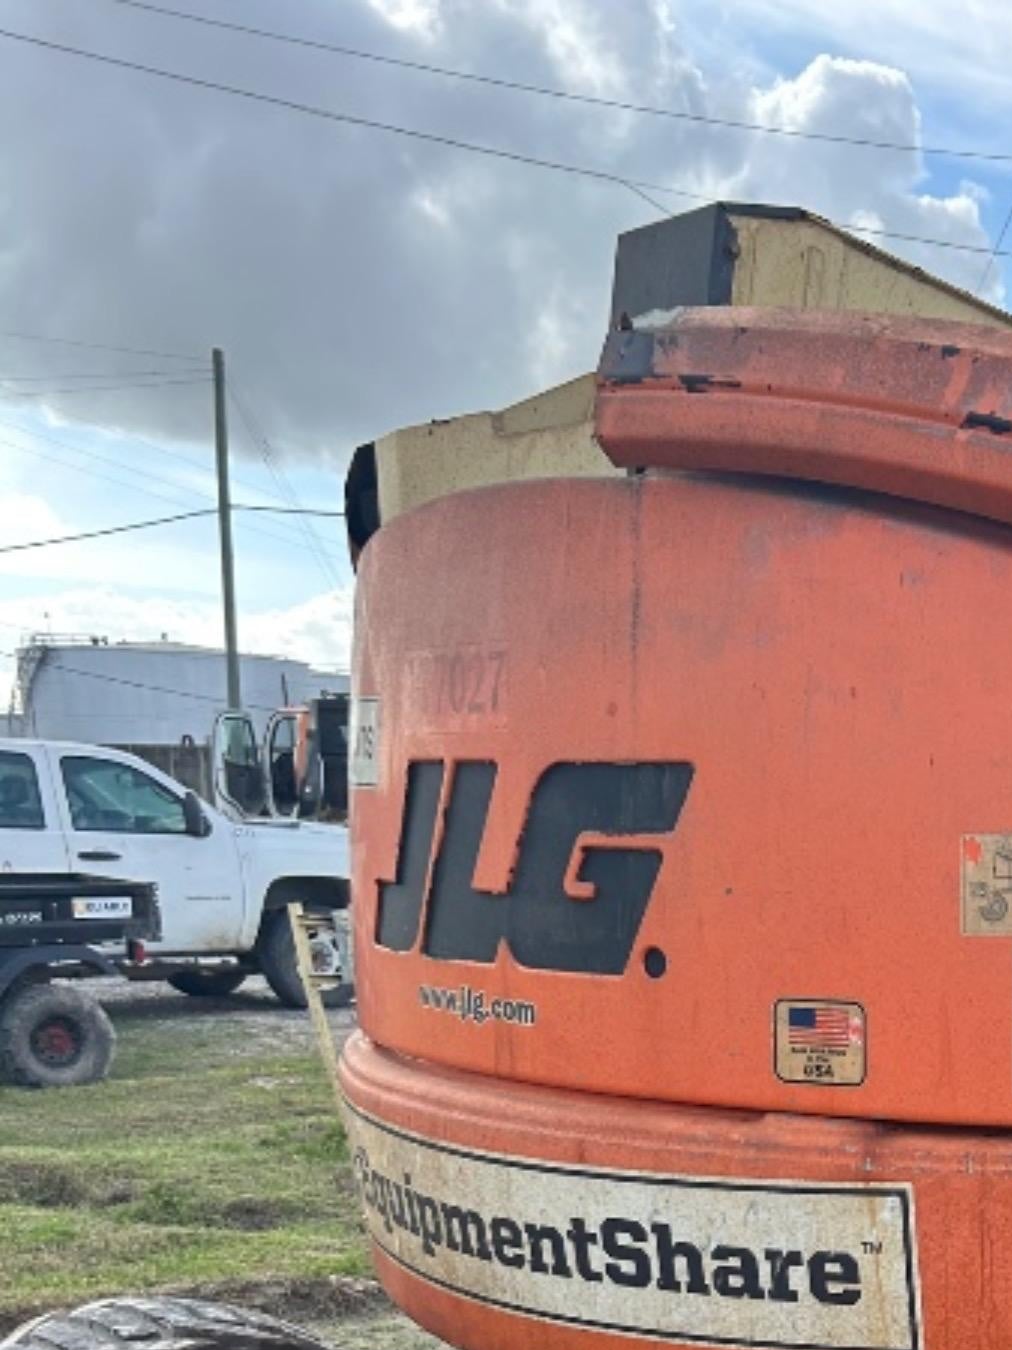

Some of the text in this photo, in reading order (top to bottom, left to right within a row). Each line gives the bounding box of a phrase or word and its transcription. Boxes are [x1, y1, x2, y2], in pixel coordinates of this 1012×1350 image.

[418, 985, 536, 1023] www.jlg.com
[803, 1064, 834, 1078] USA
[360, 1164, 862, 1305] EquipmentShare
